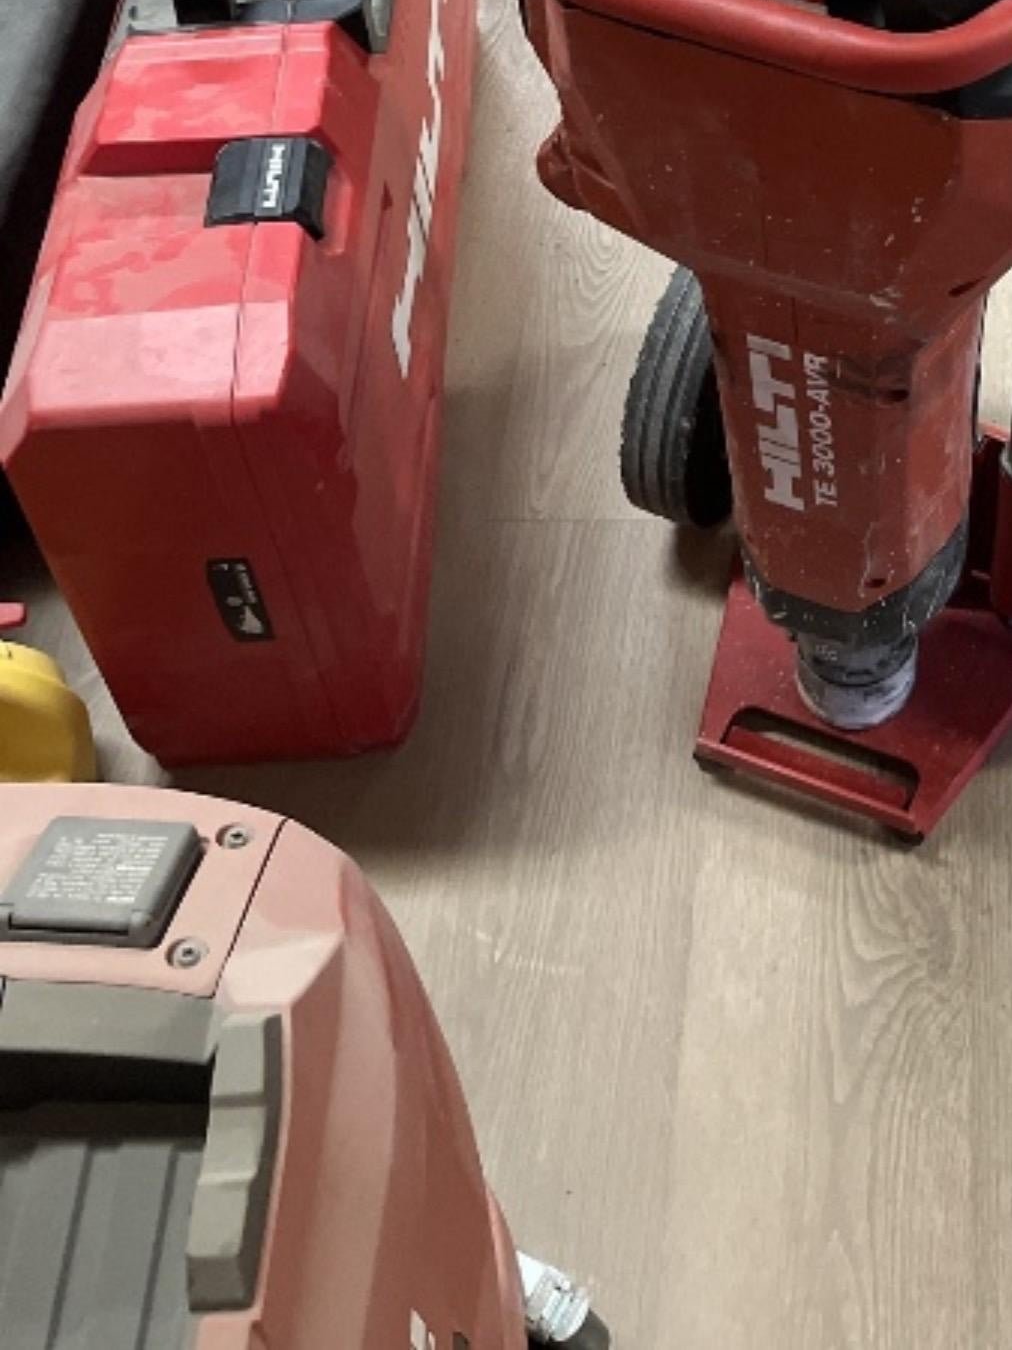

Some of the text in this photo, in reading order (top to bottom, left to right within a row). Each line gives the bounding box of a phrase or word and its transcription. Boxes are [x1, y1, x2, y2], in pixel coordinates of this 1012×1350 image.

[262, 143, 286, 208] HILTI
[746, 333, 805, 512] HILTI
[803, 351, 838, 508] TE 3000-AVR
